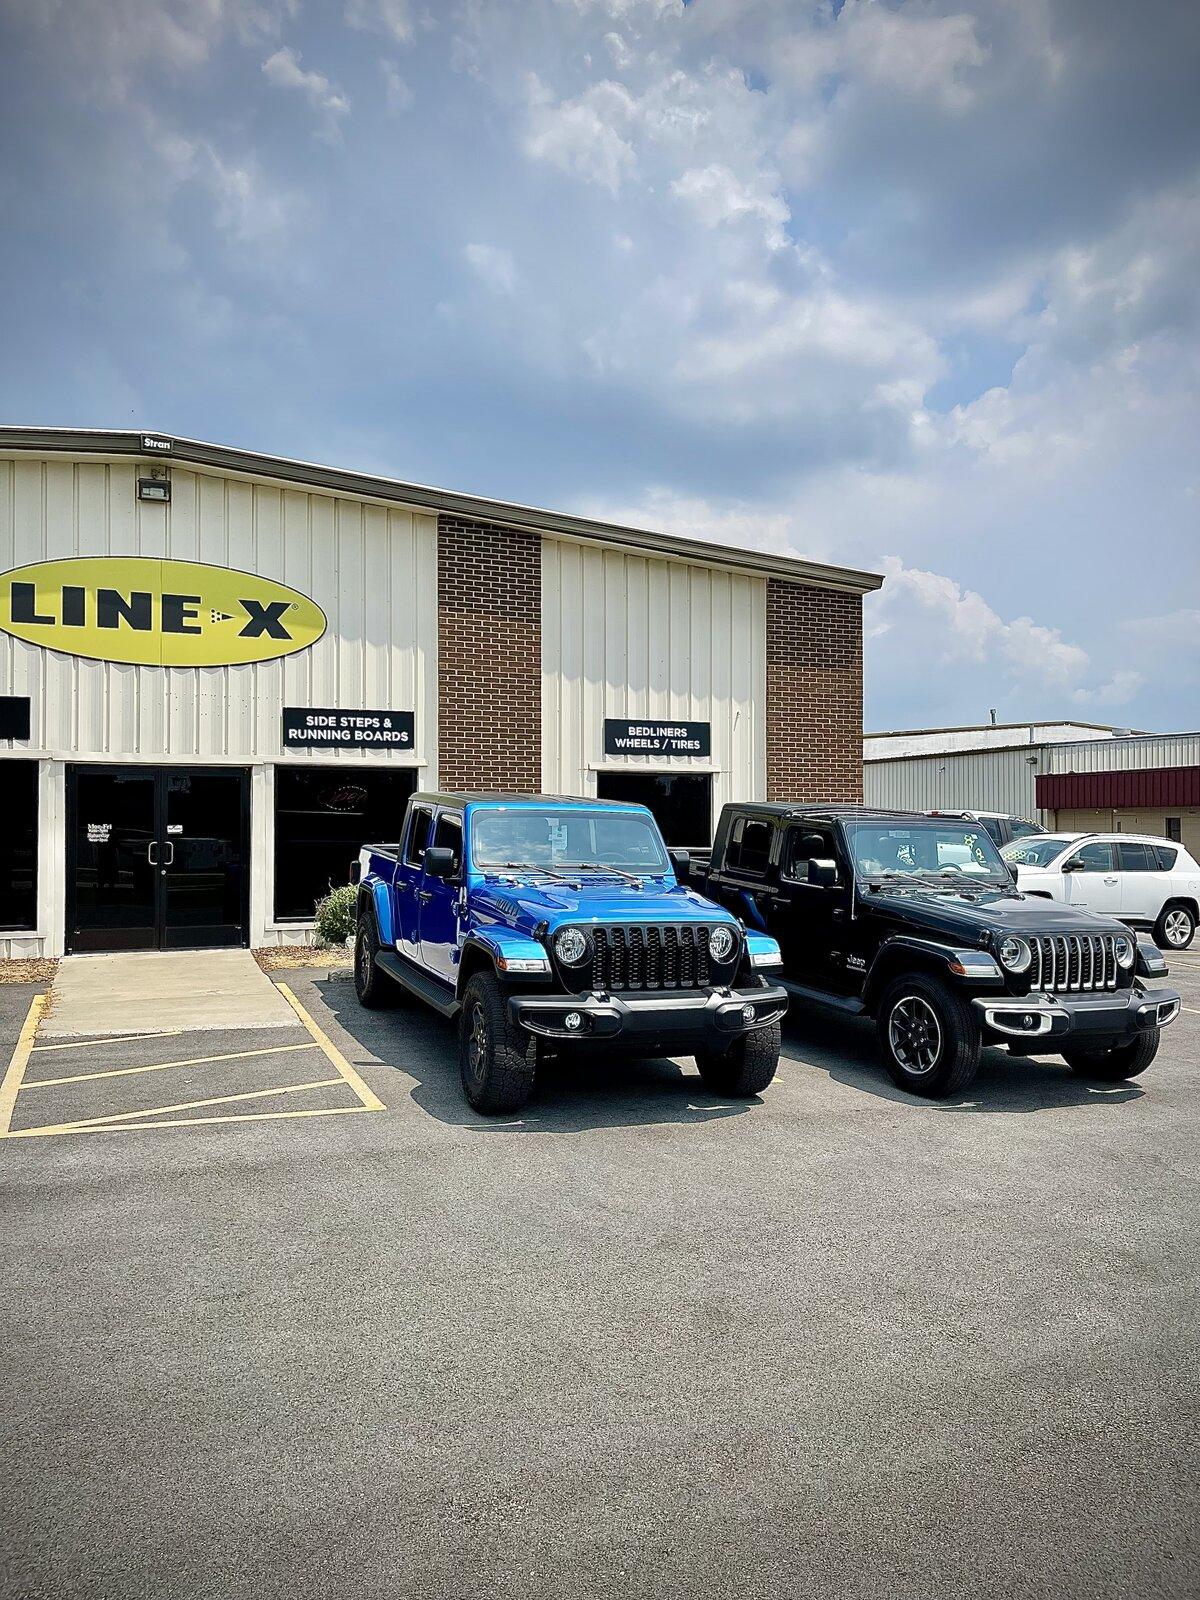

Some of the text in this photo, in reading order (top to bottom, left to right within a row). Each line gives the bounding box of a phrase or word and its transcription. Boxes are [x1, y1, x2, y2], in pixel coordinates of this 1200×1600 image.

[144, 437, 171, 449] Stran
[306, 715, 392, 728] SIDE STEPS &
[288, 729, 409, 742] RUNNING BOARDS
[628, 727, 688, 738] BEDLINERS
[615, 738, 660, 748] WHEELS
[671, 740, 700, 749] TIRES
